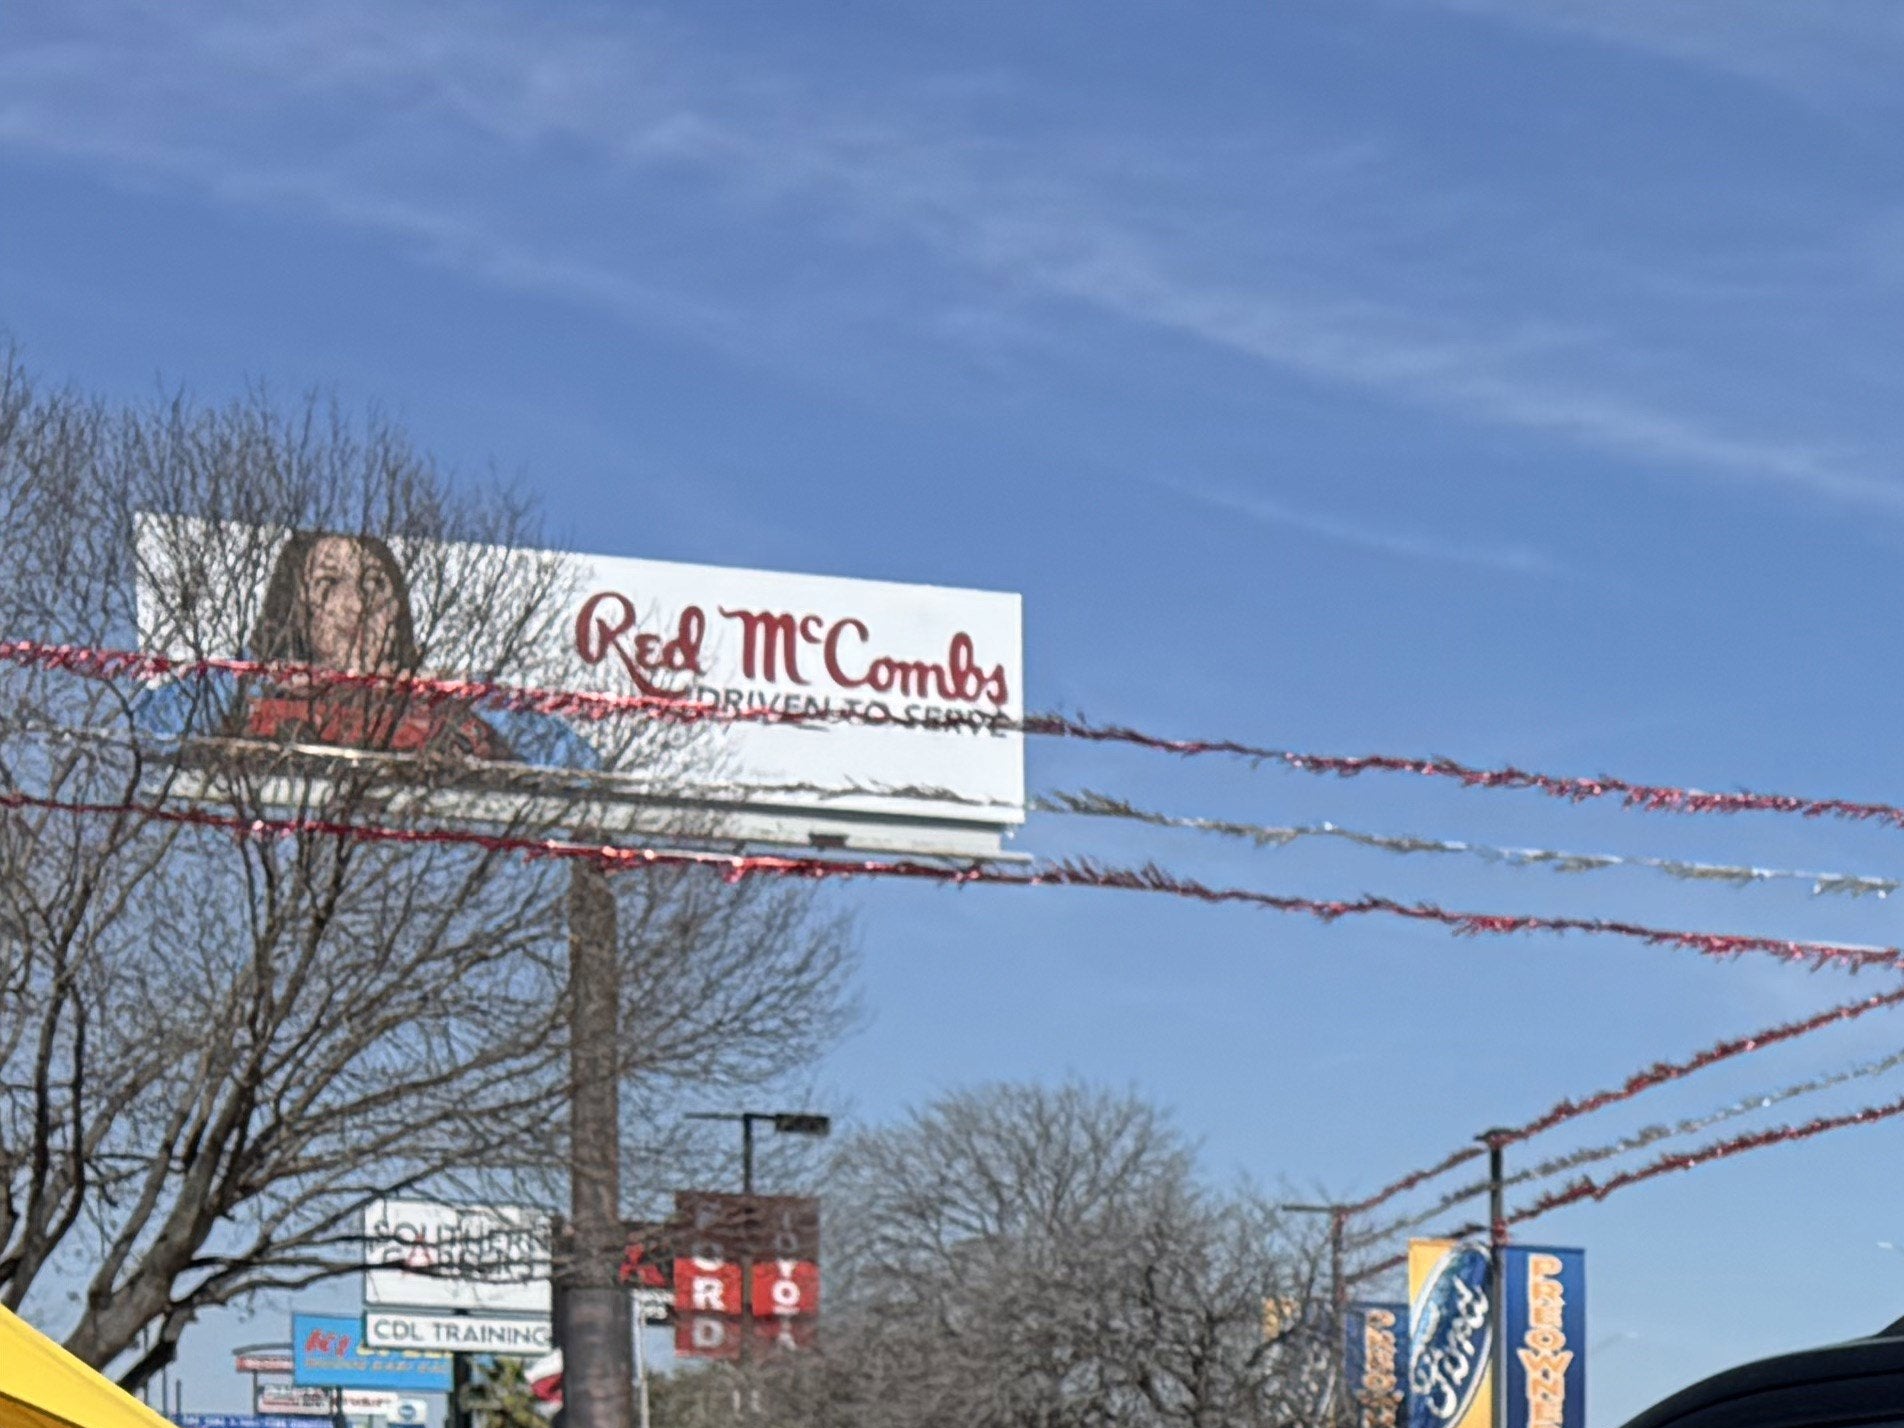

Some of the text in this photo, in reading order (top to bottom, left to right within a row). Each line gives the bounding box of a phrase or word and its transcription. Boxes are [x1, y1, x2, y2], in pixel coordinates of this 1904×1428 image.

[574, 592, 1008, 706] Red McCombs
[373, 1317, 425, 1343] CDL
[432, 1322, 551, 1349] TRAINING
